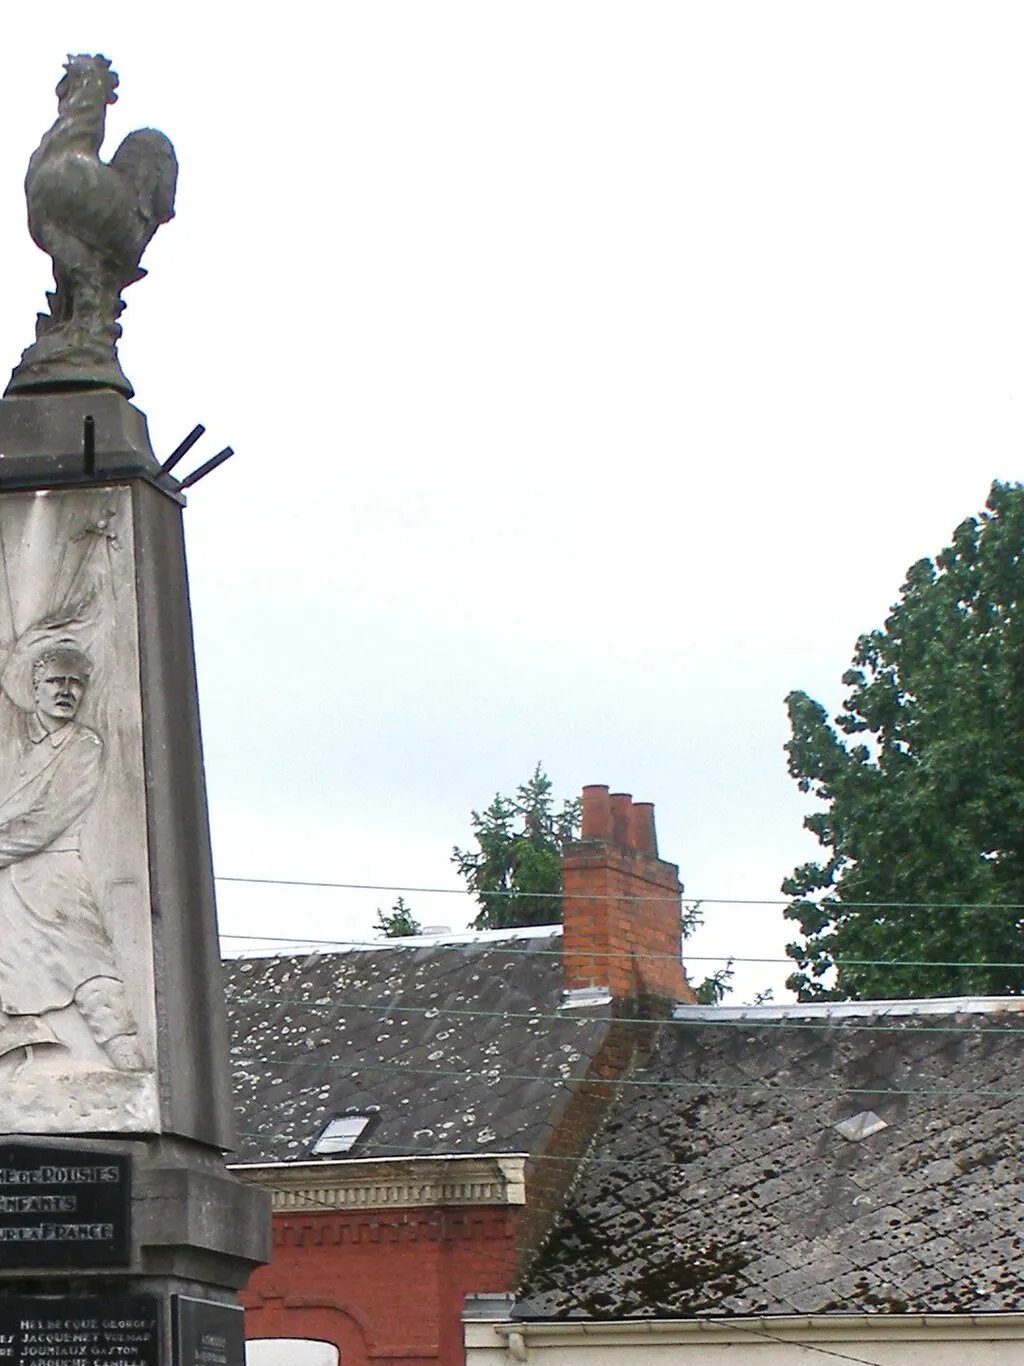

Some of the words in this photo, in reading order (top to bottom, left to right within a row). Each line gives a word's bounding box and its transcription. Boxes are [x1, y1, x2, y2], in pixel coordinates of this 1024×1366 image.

[18, 1170, 39, 1183] DE
[40, 1166, 118, 1182] ROUSIES
[20, 1228, 39, 1240] LA
[40, 1223, 113, 1240] FRANCE
[91, 1346, 138, 1355] GASTON
